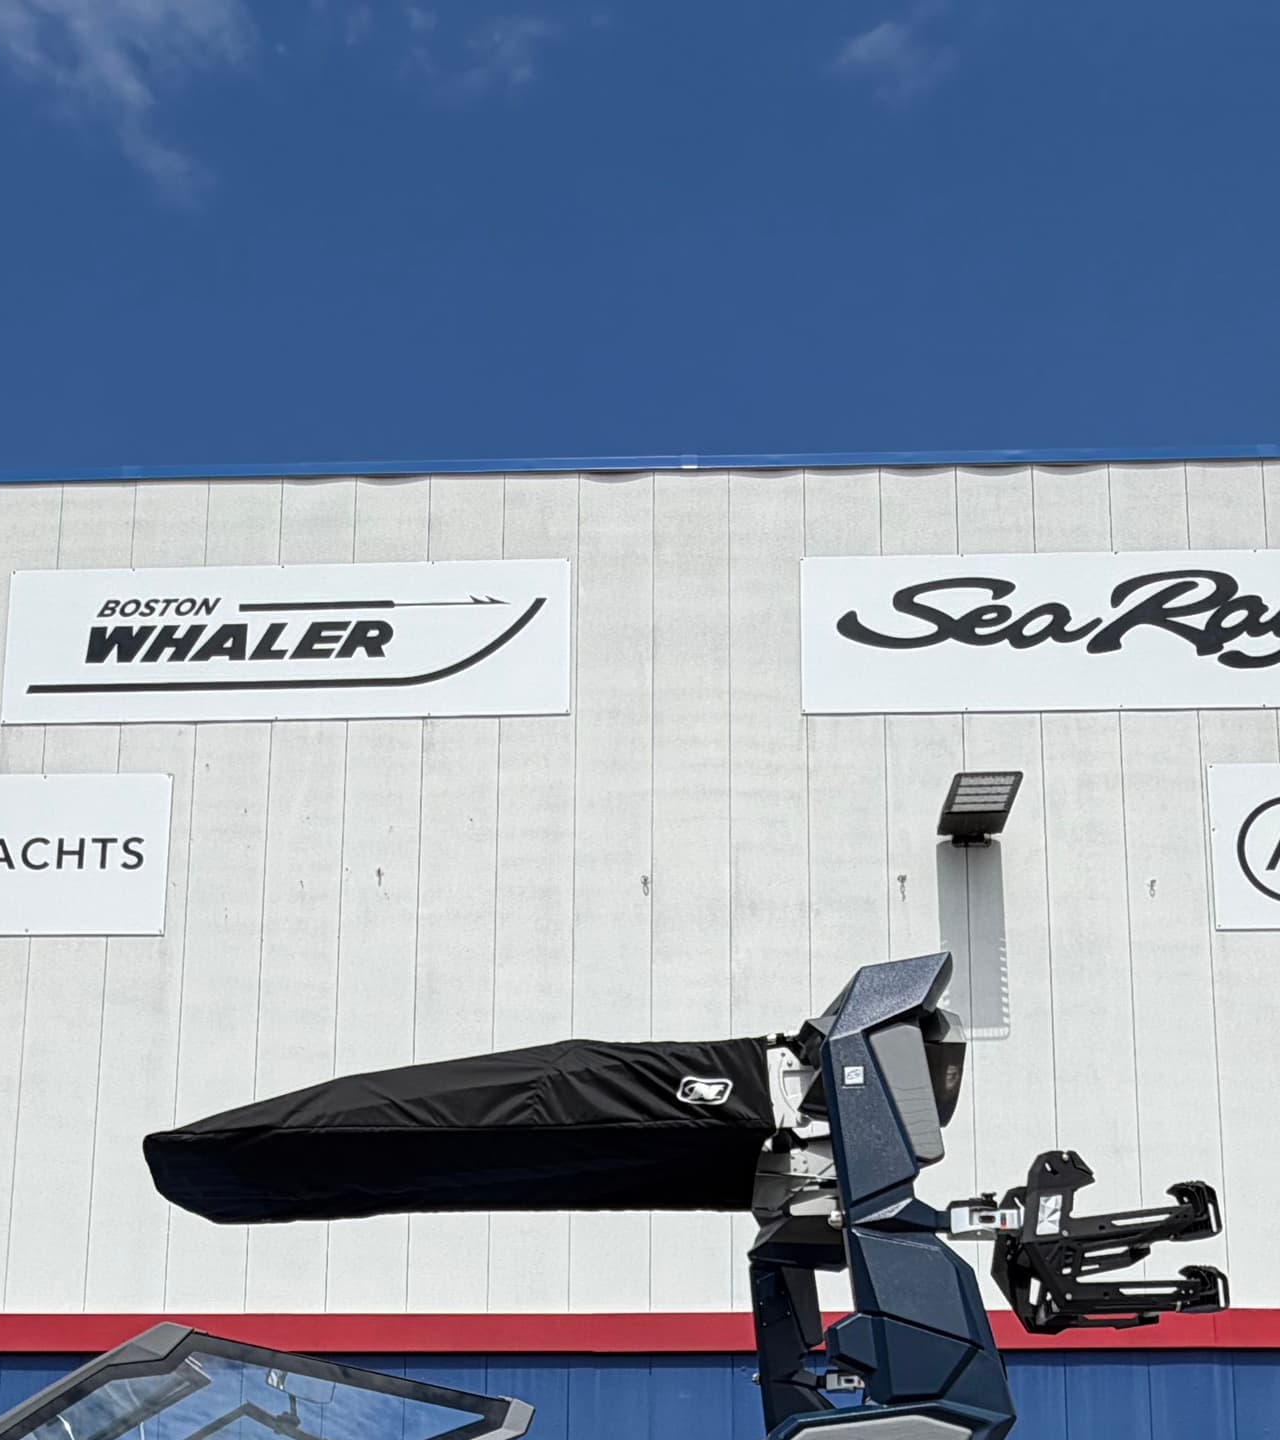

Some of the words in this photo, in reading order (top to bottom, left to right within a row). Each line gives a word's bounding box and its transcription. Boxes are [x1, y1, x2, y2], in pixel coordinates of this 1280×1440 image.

[98, 599, 220, 617] BOSTON
[836, 577, 1103, 660] Sea
[86, 621, 393, 663] WHALER
